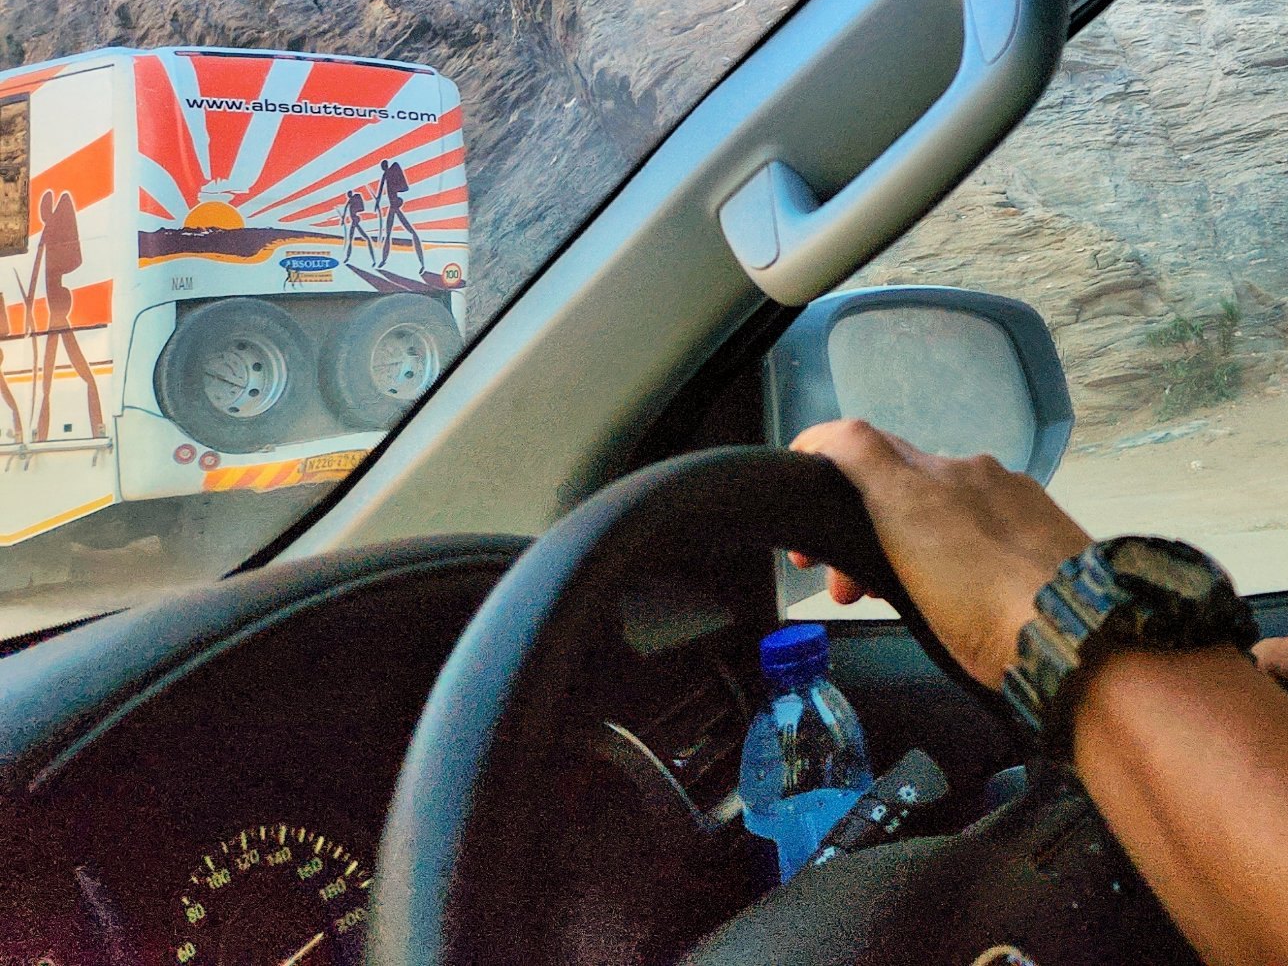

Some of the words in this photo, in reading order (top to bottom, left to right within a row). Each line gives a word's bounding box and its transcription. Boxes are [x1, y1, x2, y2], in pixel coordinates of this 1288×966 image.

[185, 97, 437, 123] www.absoluttours.com
[285, 259, 330, 269] ABSOLUT
[446, 269, 459, 280] 100
[171, 277, 193, 291] NAM
[236, 849, 260, 871] 120
[267, 846, 292, 867] 140
[207, 868, 231, 890] 100
[186, 903, 206, 924] 80
[177, 941, 196, 963] 60
